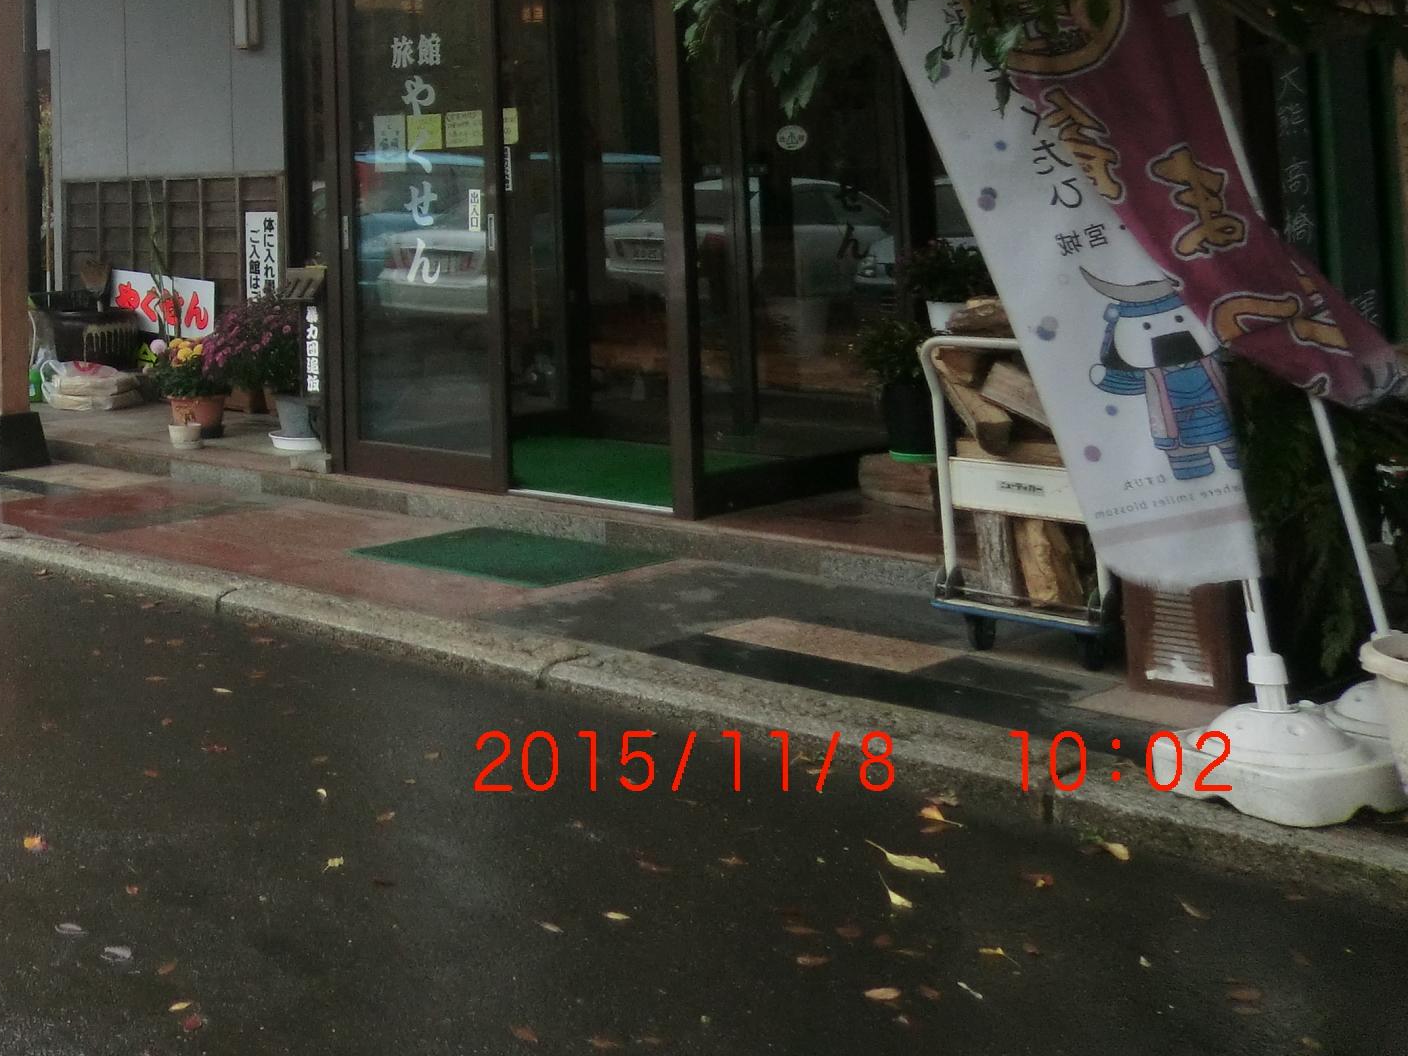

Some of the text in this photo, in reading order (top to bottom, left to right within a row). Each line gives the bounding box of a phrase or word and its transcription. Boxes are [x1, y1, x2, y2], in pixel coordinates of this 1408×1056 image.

[391, 32, 441, 69] 旅館
[401, 75, 441, 284] やくせん
[470, 192, 480, 228] 出入口
[115, 281, 209, 330] やくせん
